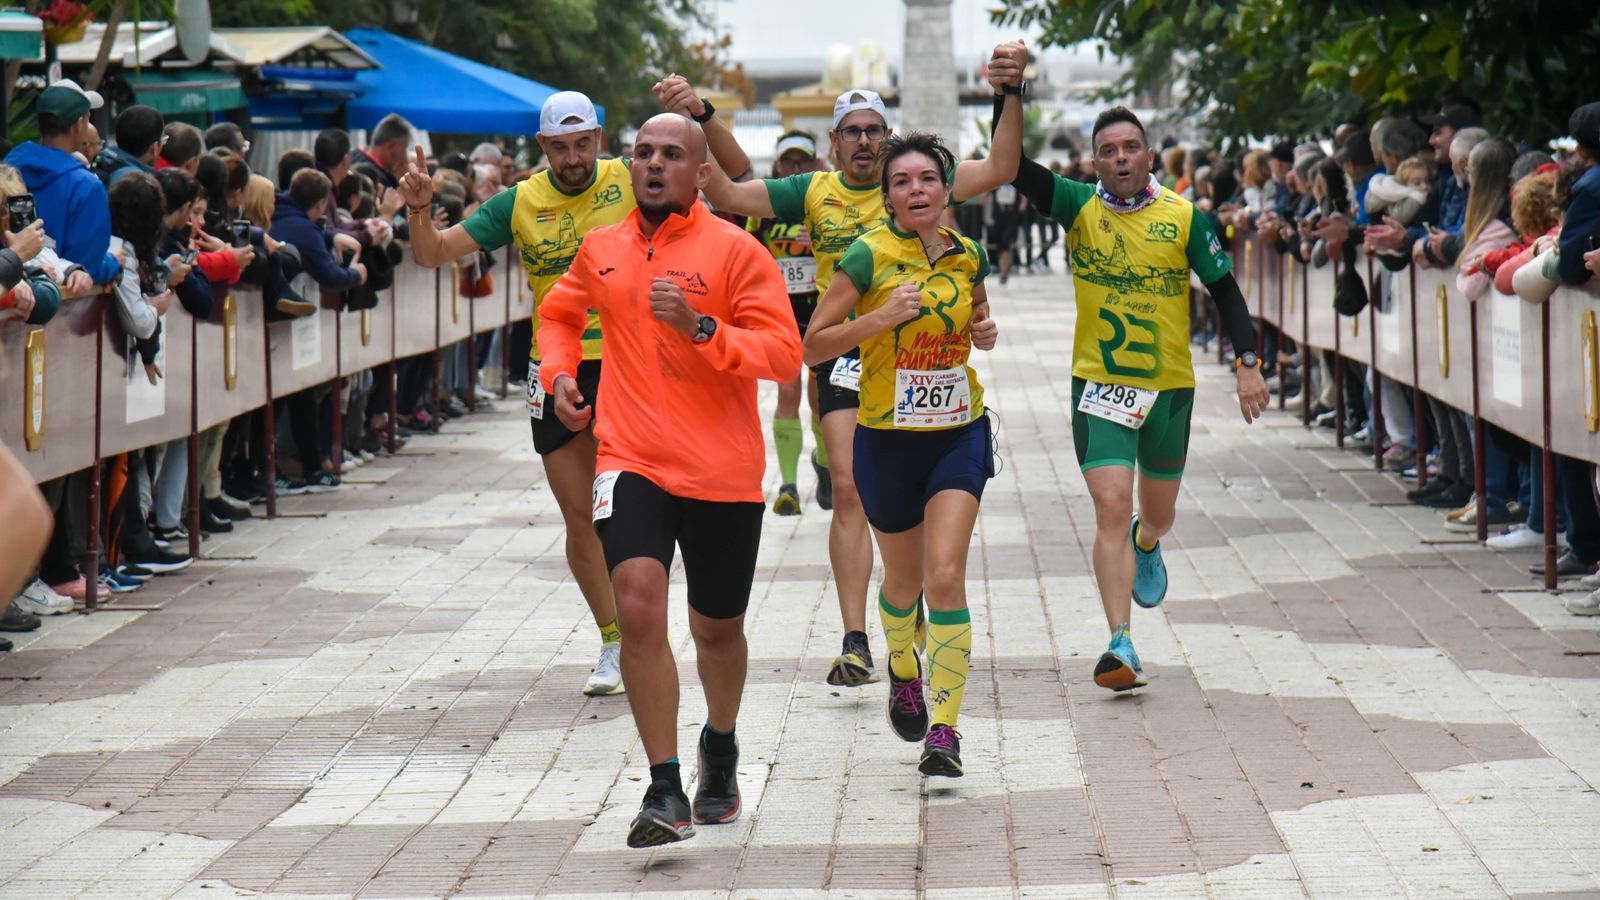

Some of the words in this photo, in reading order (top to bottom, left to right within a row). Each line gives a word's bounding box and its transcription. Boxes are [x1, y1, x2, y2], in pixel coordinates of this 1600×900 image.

[788, 267, 804, 281] 85
[909, 374, 935, 386] XIV
[915, 384, 955, 408] 267
[1100, 383, 1138, 409] 298
